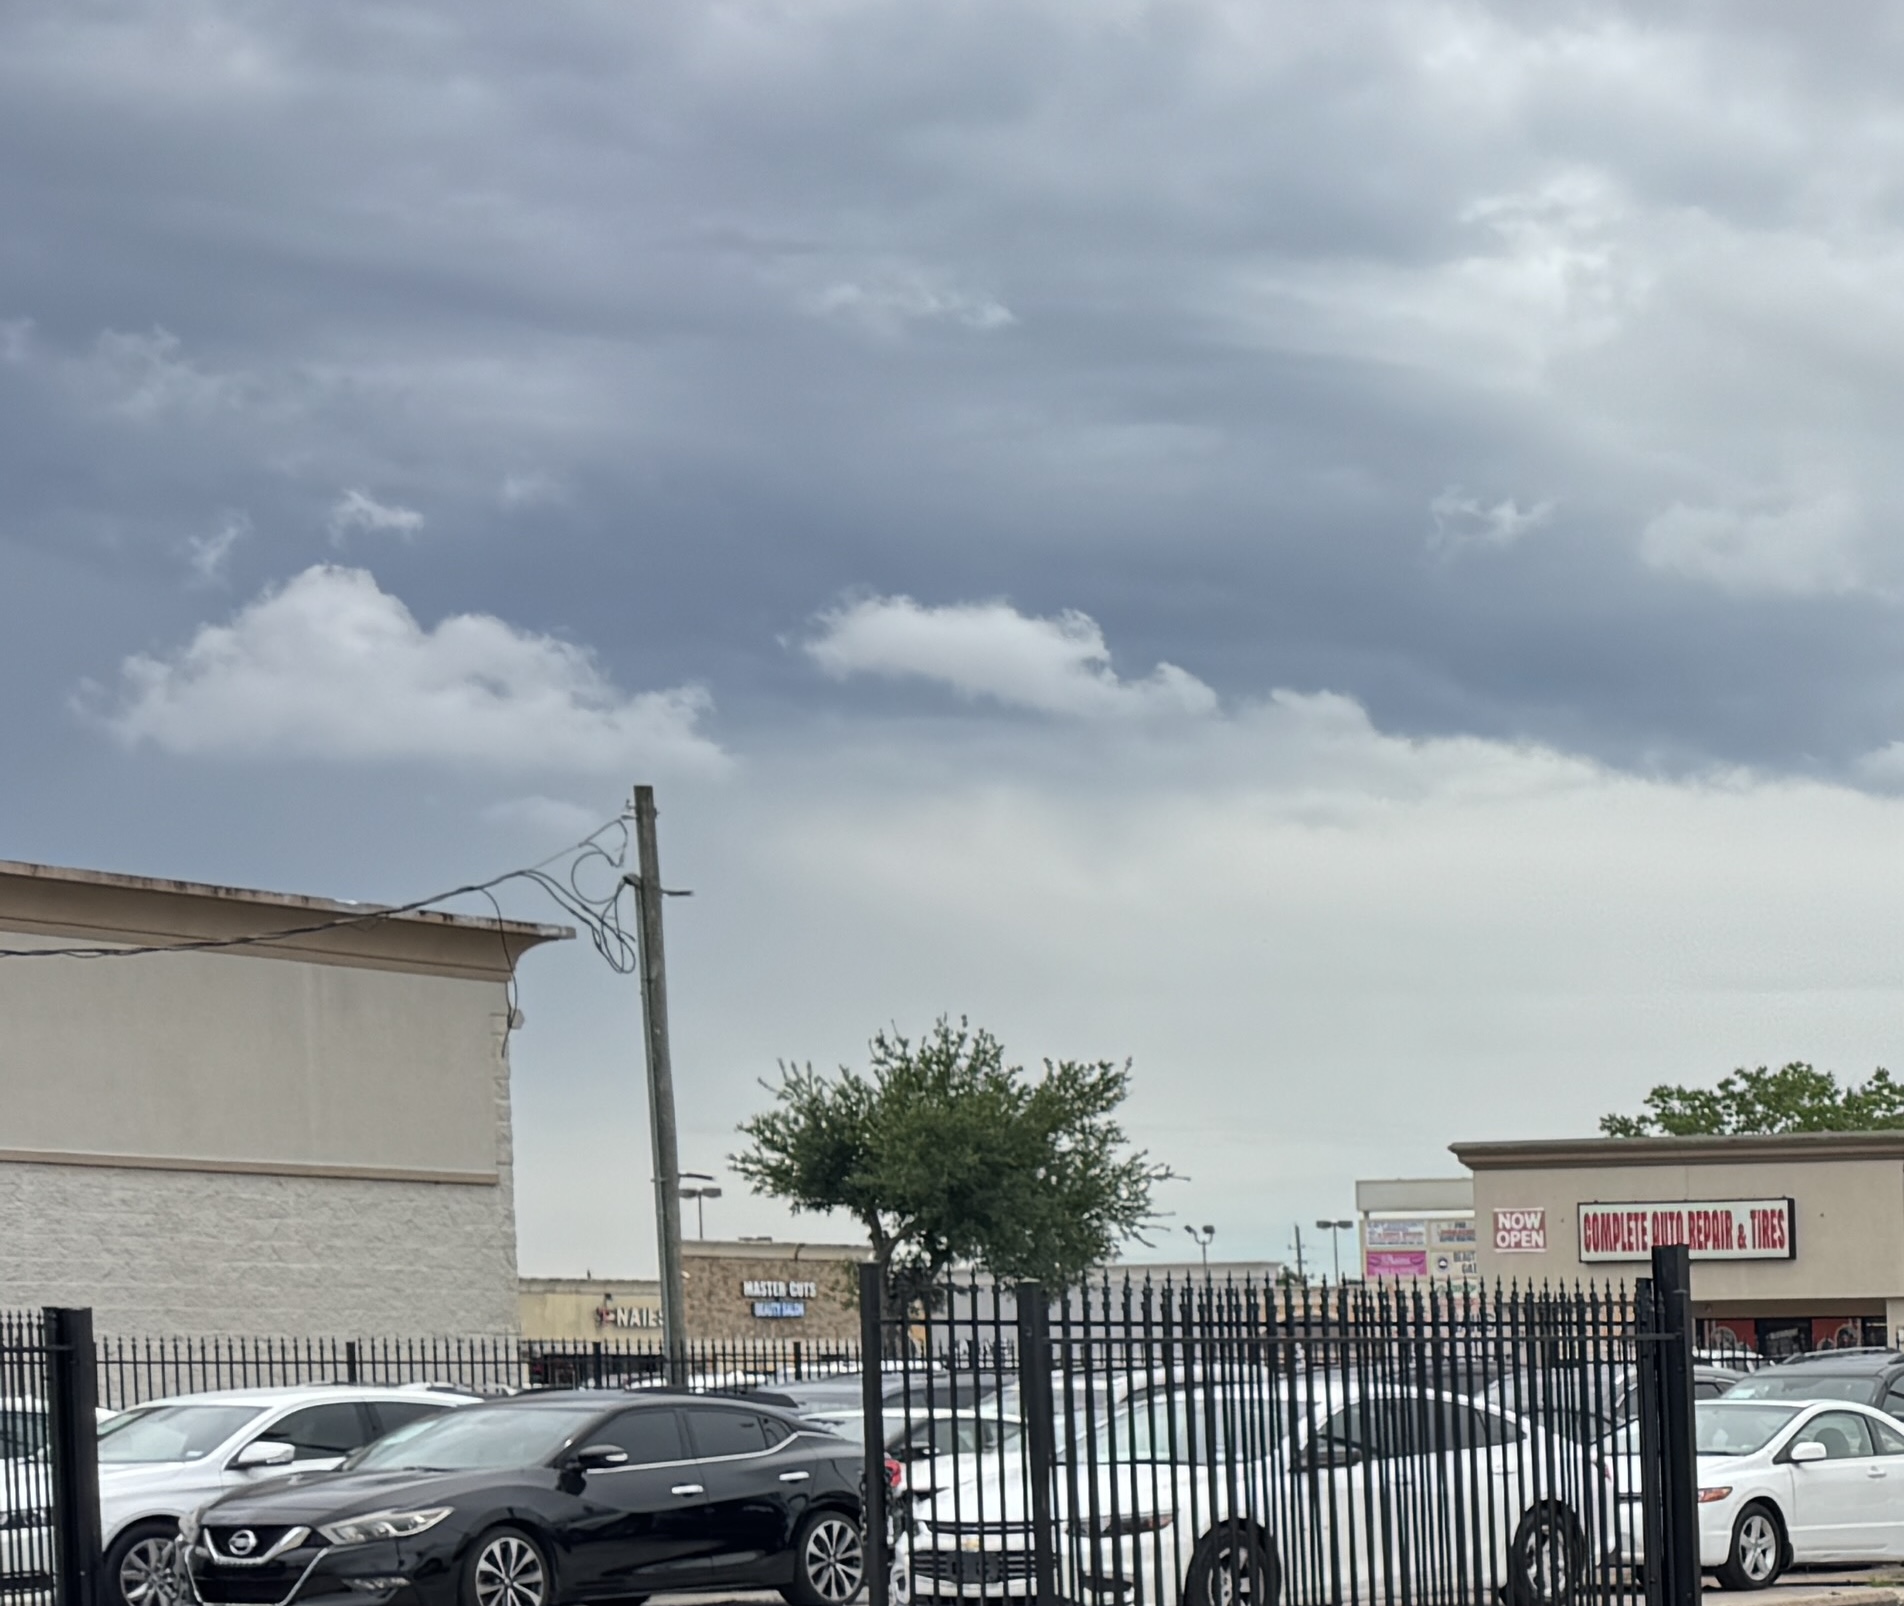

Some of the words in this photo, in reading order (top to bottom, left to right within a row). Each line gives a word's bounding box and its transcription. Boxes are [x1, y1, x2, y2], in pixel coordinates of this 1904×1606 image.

[1498, 1212, 1542, 1229] NOW
[1496, 1230, 1544, 1248] OPEN
[1583, 1211, 1649, 1253] COMPLETE
[1652, 1210, 1684, 1246] AUTO
[1687, 1209, 1734, 1250] REPAIR
[1737, 1223, 1747, 1250] &
[1750, 1208, 1786, 1250] TIRES
[743, 1280, 787, 1298] MASTER
